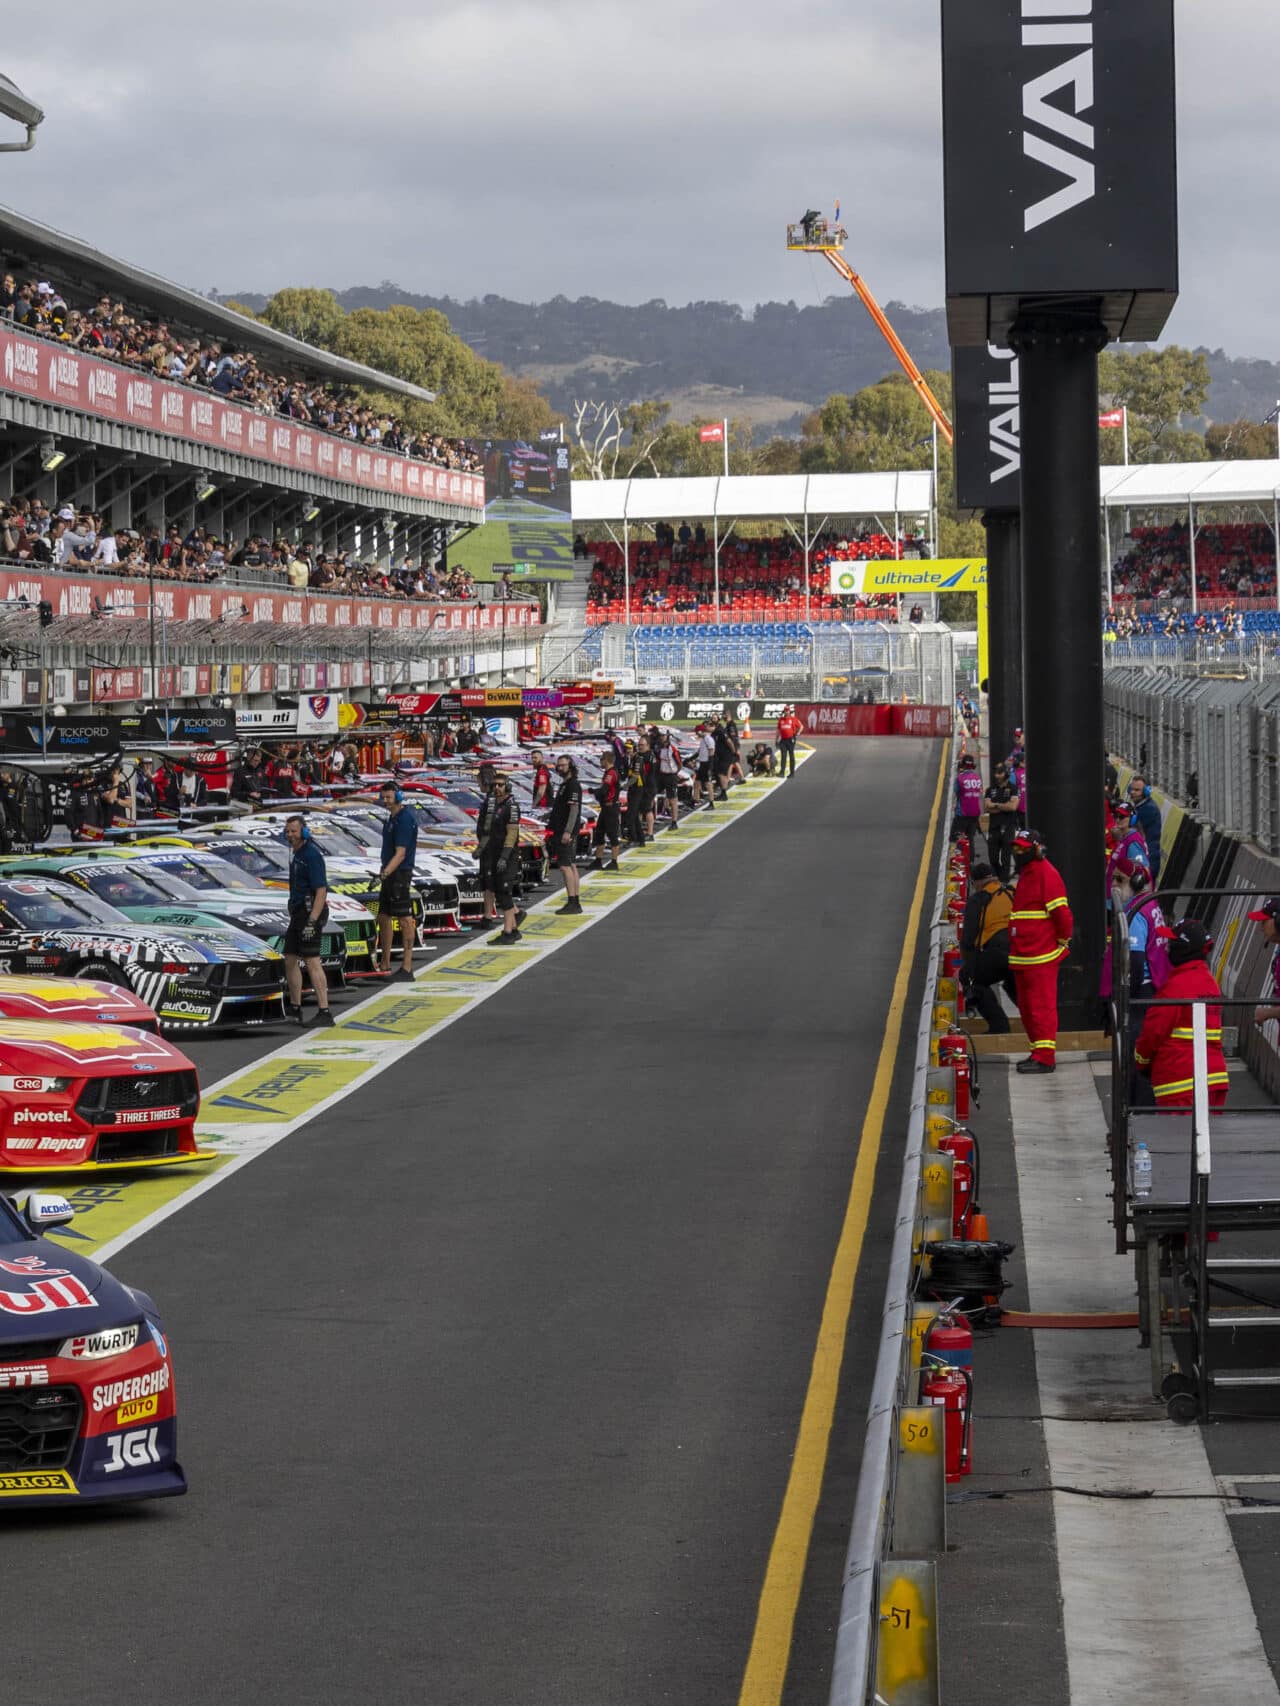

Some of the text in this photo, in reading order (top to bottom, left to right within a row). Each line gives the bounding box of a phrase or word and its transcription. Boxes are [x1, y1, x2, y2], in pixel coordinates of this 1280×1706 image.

[874, 571, 941, 585] ultimate
[15, 1079, 41, 1090] CRC
[13, 1107, 72, 1125] pivotel.
[122, 1108, 177, 1123] THREE THREES
[36, 1137, 86, 1152] Repco
[88, 1329, 136, 1353] WÜRTH
[121, 1400, 153, 1419] AUTO
[907, 1423, 929, 1442] 50
[104, 1427, 161, 1473] JGI
[891, 1606, 910, 1630] 51
